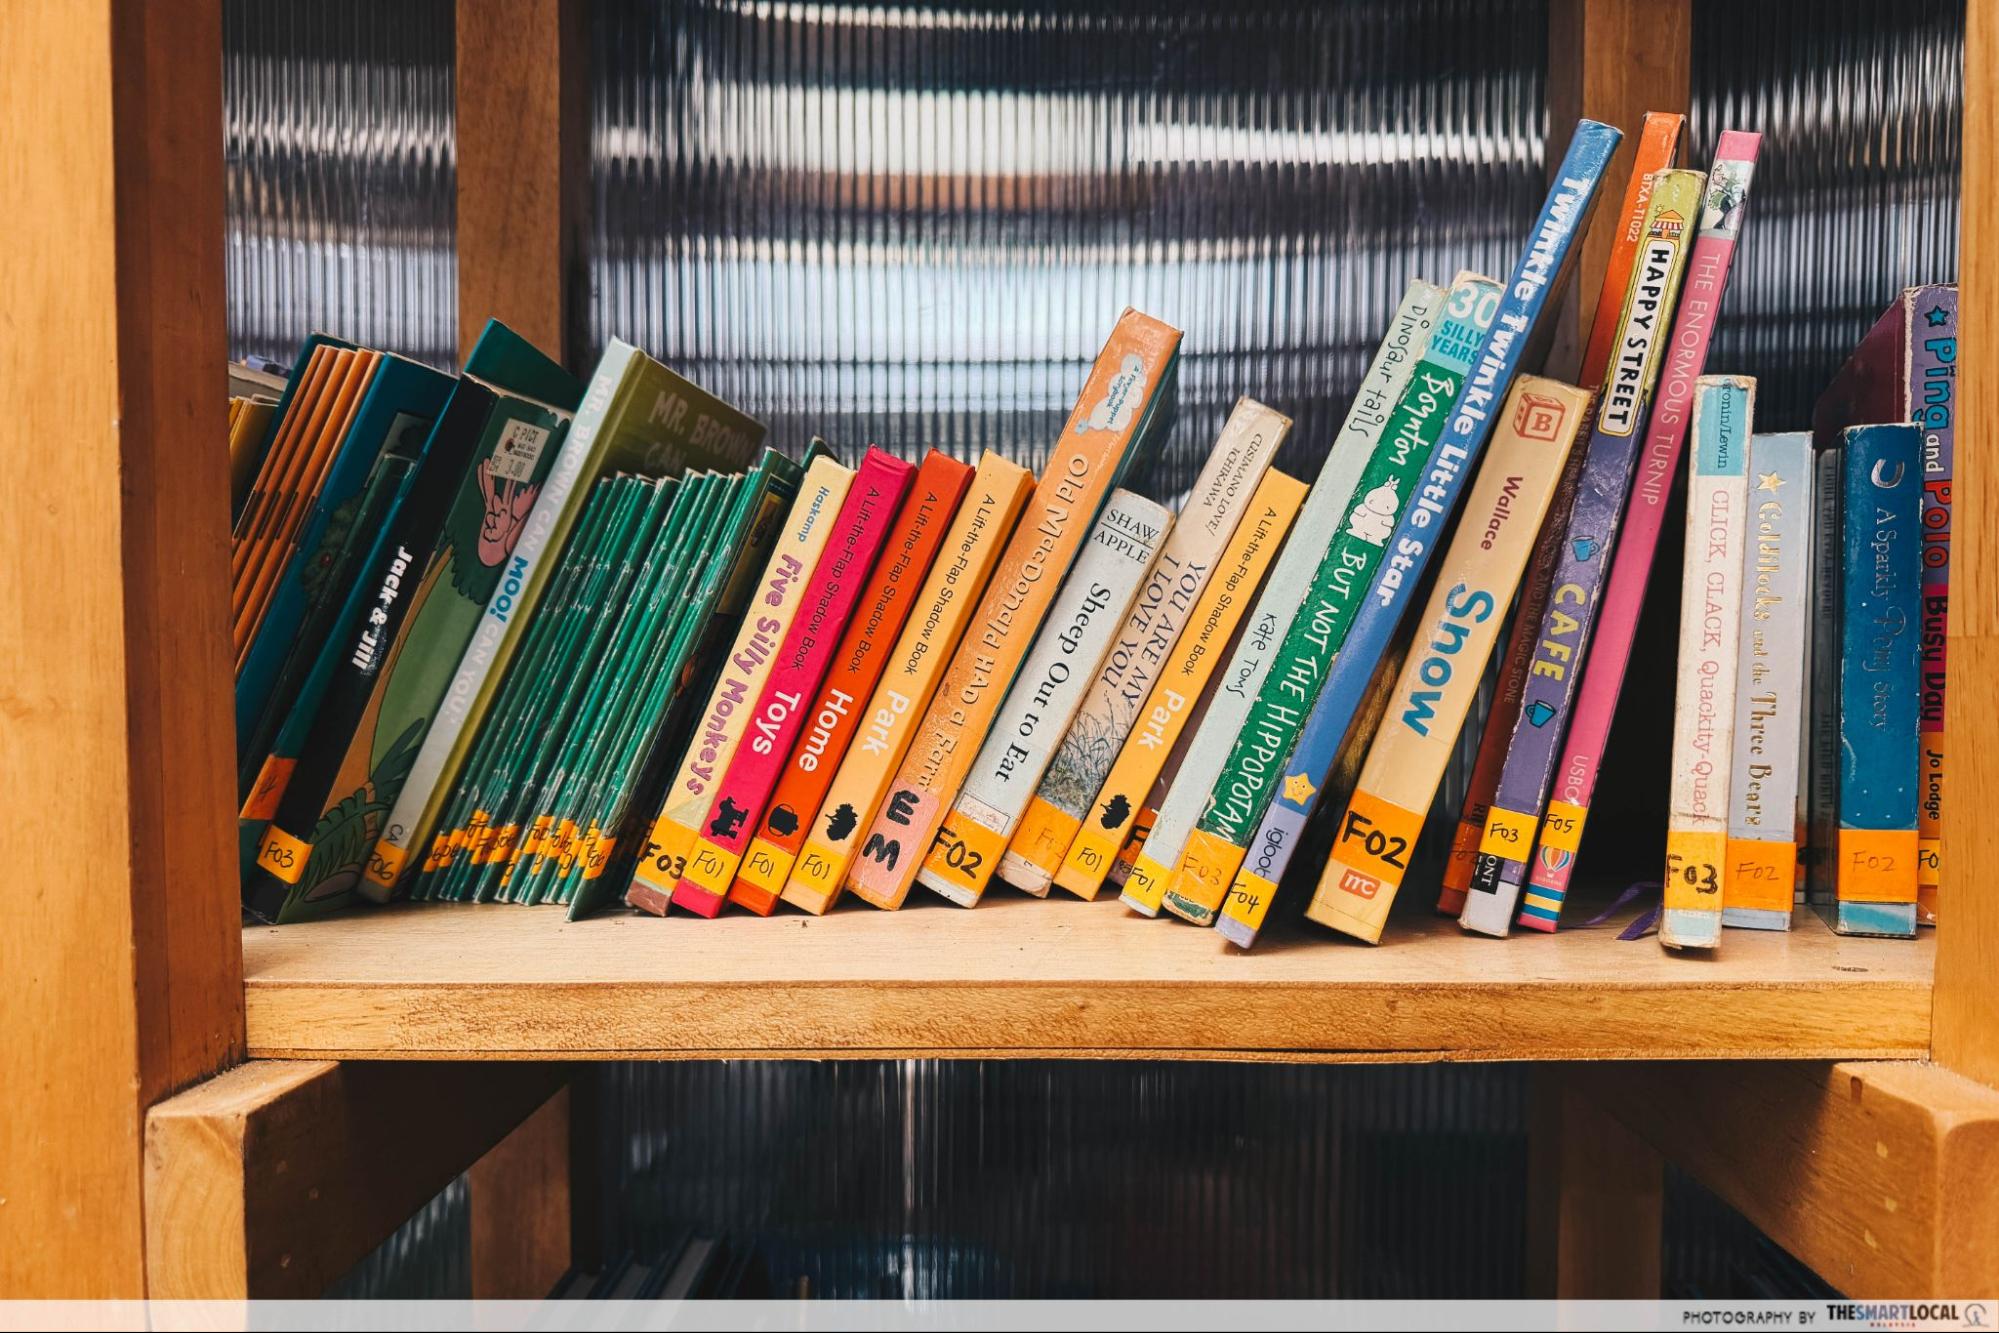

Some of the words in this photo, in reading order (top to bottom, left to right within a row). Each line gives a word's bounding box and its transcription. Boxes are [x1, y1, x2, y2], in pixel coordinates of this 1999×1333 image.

[1514, 177, 1592, 301] Twinkle
[1633, 248, 1670, 331] HAPPY
[1694, 253, 1721, 291] THE
[1440, 319, 1484, 348] SILLY
[1448, 282, 1501, 331] 30
[1453, 313, 1530, 436] Twinkle
[1609, 336, 1647, 425] STREET
[1661, 301, 1709, 425] ENORMOUS
[1912, 337, 1957, 430] Ping
[1388, 372, 1455, 466] Boynton
[1532, 412, 1553, 432] B
[1056, 454, 1089, 503] Old
[1203, 447, 1240, 507] ICHIKAWA
[1227, 432, 1263, 498] CUSIMANO
[1641, 434, 1675, 505] TURNIP
[1925, 433, 1945, 473] and
[869, 487, 880, 498] A
[925, 492, 938, 503] A
[982, 493, 996, 505] A
[1264, 506, 1278, 519] A
[1410, 443, 1468, 529] Little
[1480, 475, 1523, 551] Wallace
[798, 486, 830, 543] Haskamp
[832, 498, 876, 579] Lift-the-Flap
[1106, 508, 1160, 540] SHAW
[1705, 490, 1730, 563] CLICK,
[1876, 507, 1896, 525] A
[1924, 479, 1952, 568] Polo
[888, 504, 934, 583] Lift-the-Flap
[945, 507, 991, 585] Lift-the-Flap
[1093, 529, 1150, 565] APPLE
[1164, 552, 1181, 570] I
[1225, 518, 1273, 593] Lift-the-Flap
[1753, 502, 1783, 621] Goldilocks
[1870, 529, 1897, 600] Sparkly
[379, 545, 413, 606] Jack
[489, 556, 529, 623] MOO!
[764, 553, 803, 607] Five
[1168, 561, 1207, 614] YOU
[1327, 546, 1367, 601] BUT
[1376, 537, 1424, 608] Star
[369, 606, 388, 625] &
[808, 581, 840, 635] Shadow
[865, 586, 896, 638] Shadow
[922, 587, 954, 641] Shadow
[1058, 581, 1112, 655] Sheep
[1129, 568, 1173, 633] LOVE
[1200, 593, 1233, 644] Shadow
[1304, 599, 1340, 655] NOT
[1702, 571, 1725, 651] CLACK,
[352, 630, 377, 670] Jill
[733, 616, 781, 675] Silly
[791, 636, 816, 671] Book
[1141, 613, 1175, 666] ARE
[1515, 622, 1537, 665] MAGIC
[1533, 583, 1586, 681] CAFE
[1922, 594, 1949, 662] Busy
[848, 639, 872, 674] Book
[903, 641, 928, 676] Book
[1100, 640, 1139, 690] YOU
[1181, 644, 1206, 677] Book
[1279, 655, 1318, 702] THE
[1401, 583, 1495, 738] Snow
[1033, 662, 1070, 708] Out
[1120, 665, 1149, 709] MY
[1503, 667, 1523, 704] STONE
[1920, 672, 1946, 722] Day
[686, 678, 749, 795] Monkeys
[752, 691, 802, 756] Toys
[799, 688, 854, 772] Home
[862, 689, 911, 757] Park
[1018, 712, 1040, 737] to
[1137, 687, 1187, 751] Park
[1691, 660, 1720, 825] Quackity-Quack
[1750, 691, 1777, 755] Three
[994, 742, 1030, 783] Eat
[1212, 702, 1300, 843] HIPPOPOTAM
[1927, 749, 1943, 768] Jo
[1744, 764, 1772, 826] Bears
[1923, 771, 1943, 820] Lodge
[1342, 810, 1408, 870] F02
[1490, 822, 1519, 843] F03
[1544, 813, 1576, 833] F05
[264, 841, 294, 868] F03
[639, 842, 688, 880] F03
[692, 851, 724, 878] F01
[748, 852, 775, 878] F01
[801, 854, 831, 880] F01
[928, 825, 983, 879] F02
[1077, 846, 1103, 872] F01
[1735, 861, 1780, 882] F02
[1850, 850, 1896, 872] F02
